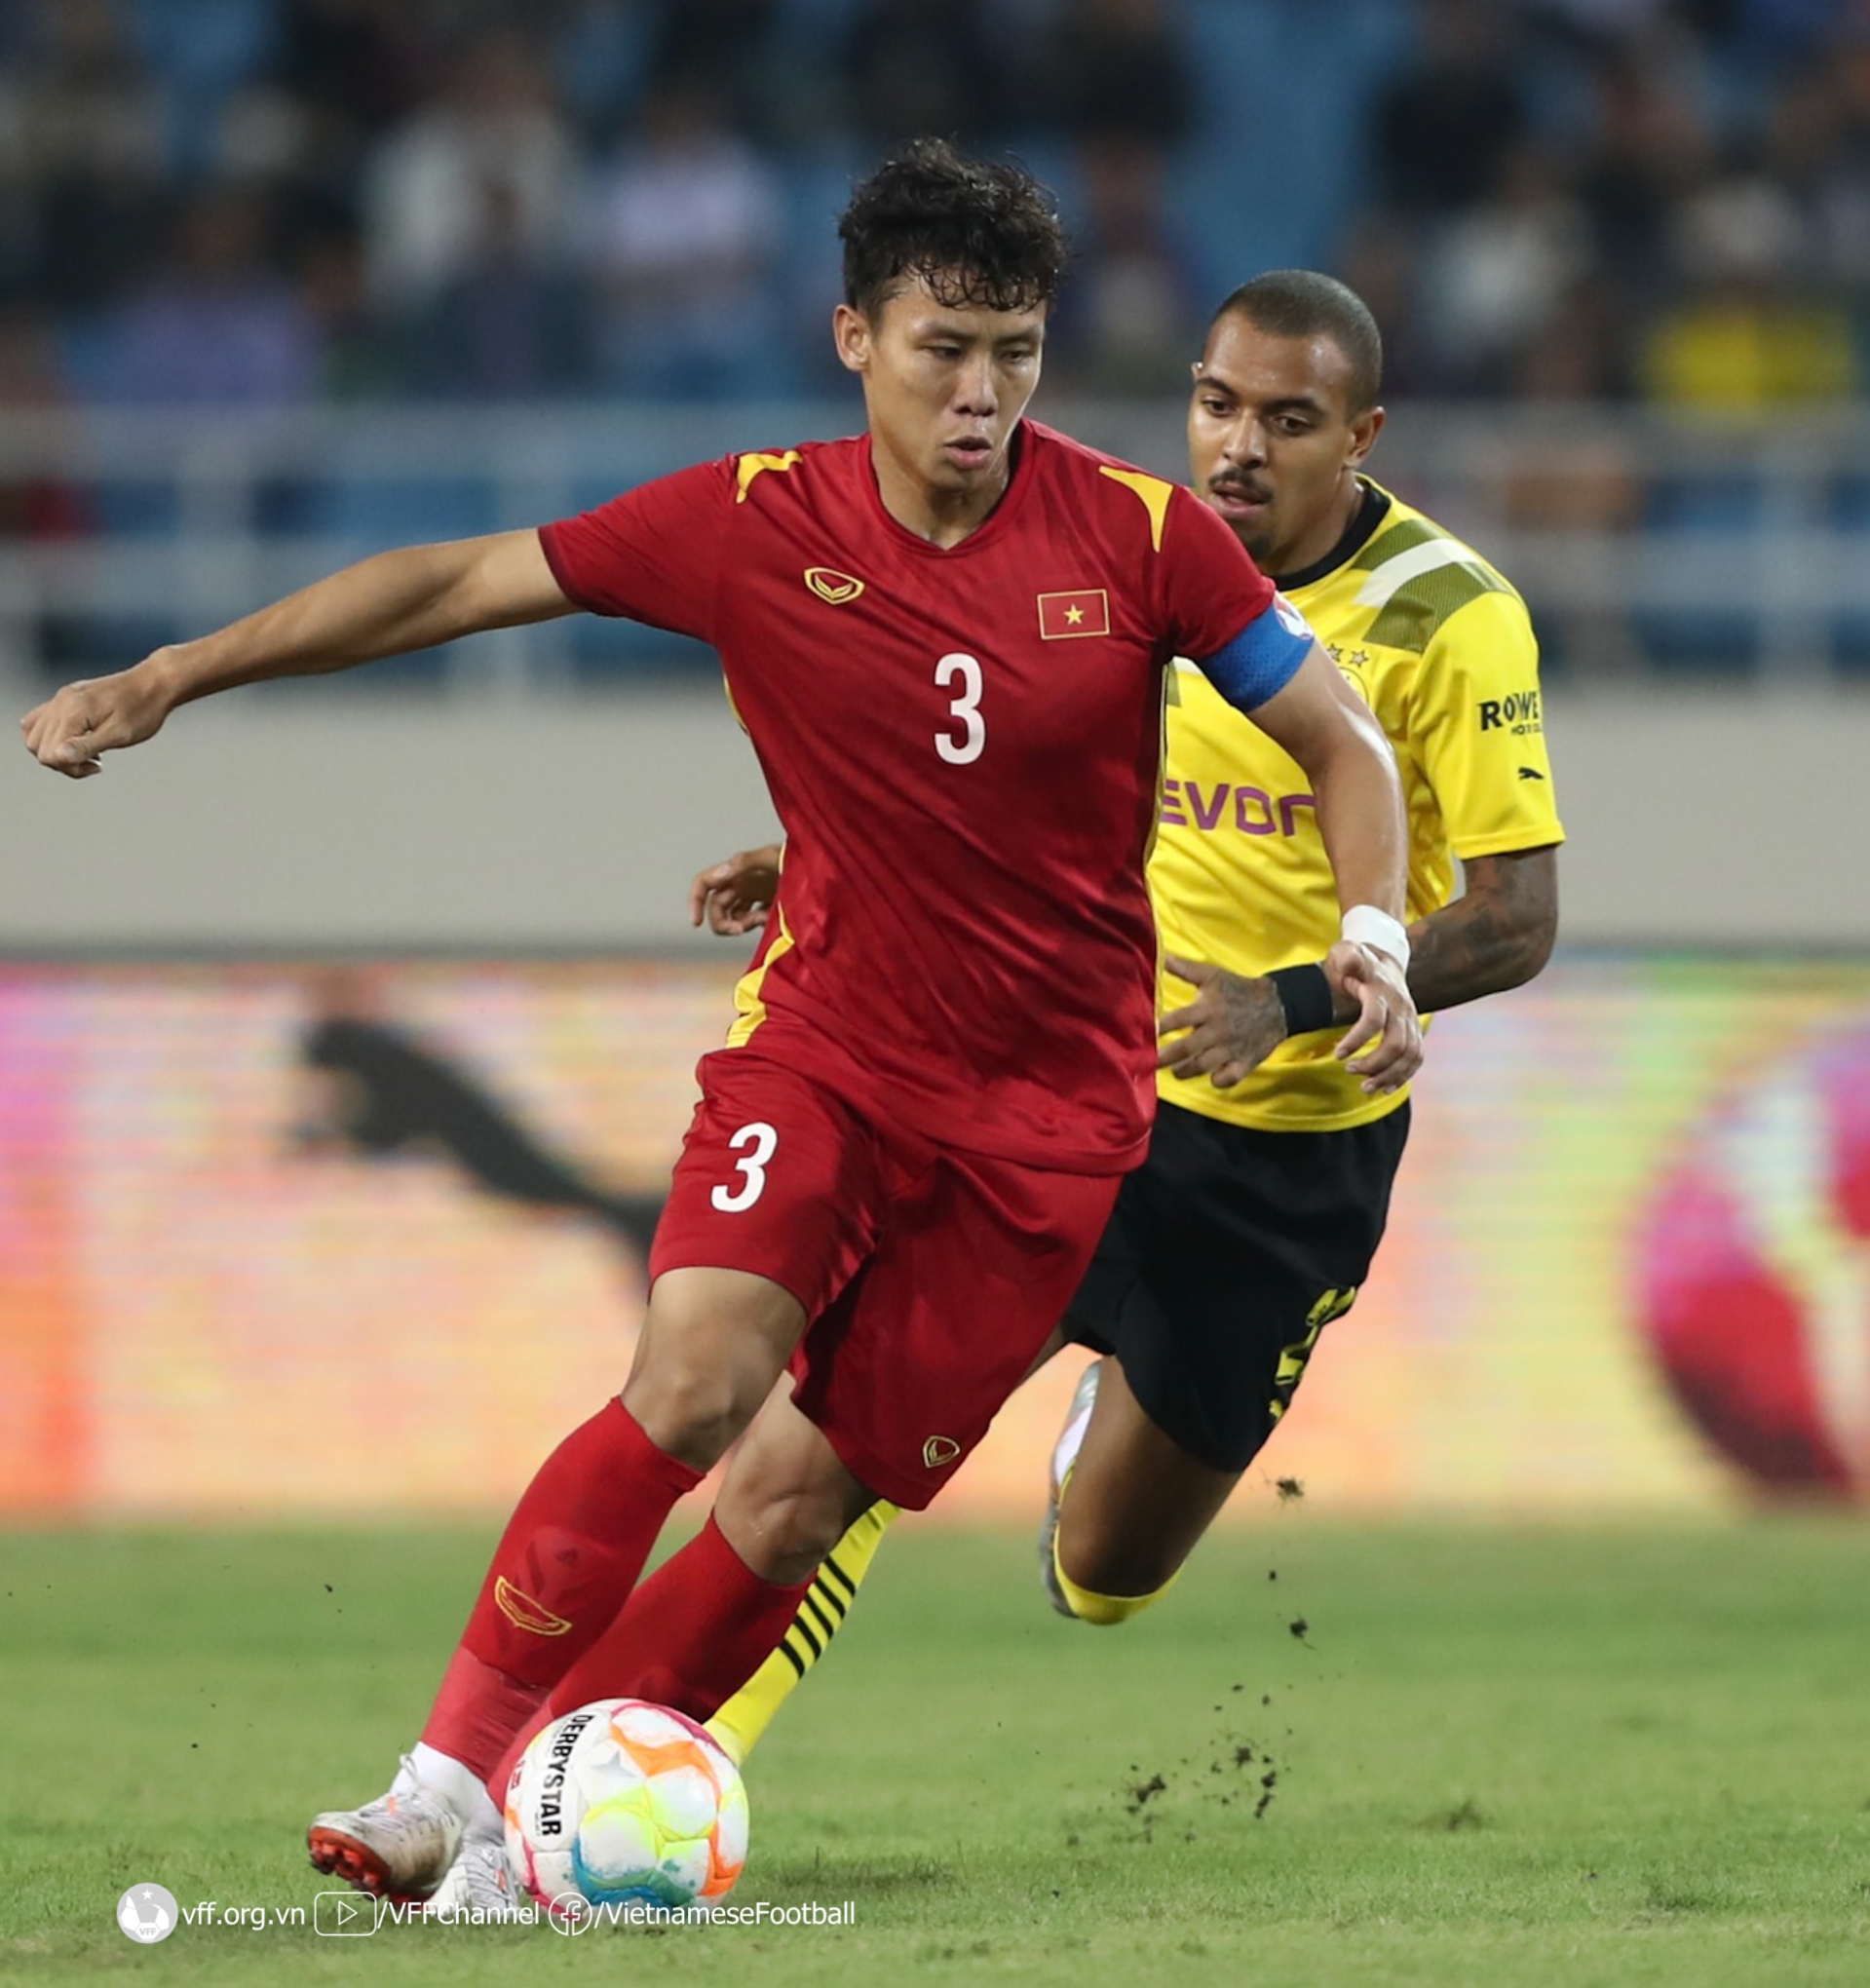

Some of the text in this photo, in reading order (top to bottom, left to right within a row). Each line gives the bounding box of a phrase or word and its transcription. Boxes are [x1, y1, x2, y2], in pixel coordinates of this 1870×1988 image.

[935, 652, 986, 765] 3
[710, 1121, 779, 1213] 3
[540, 1714, 595, 1836] DERBYSTAR
